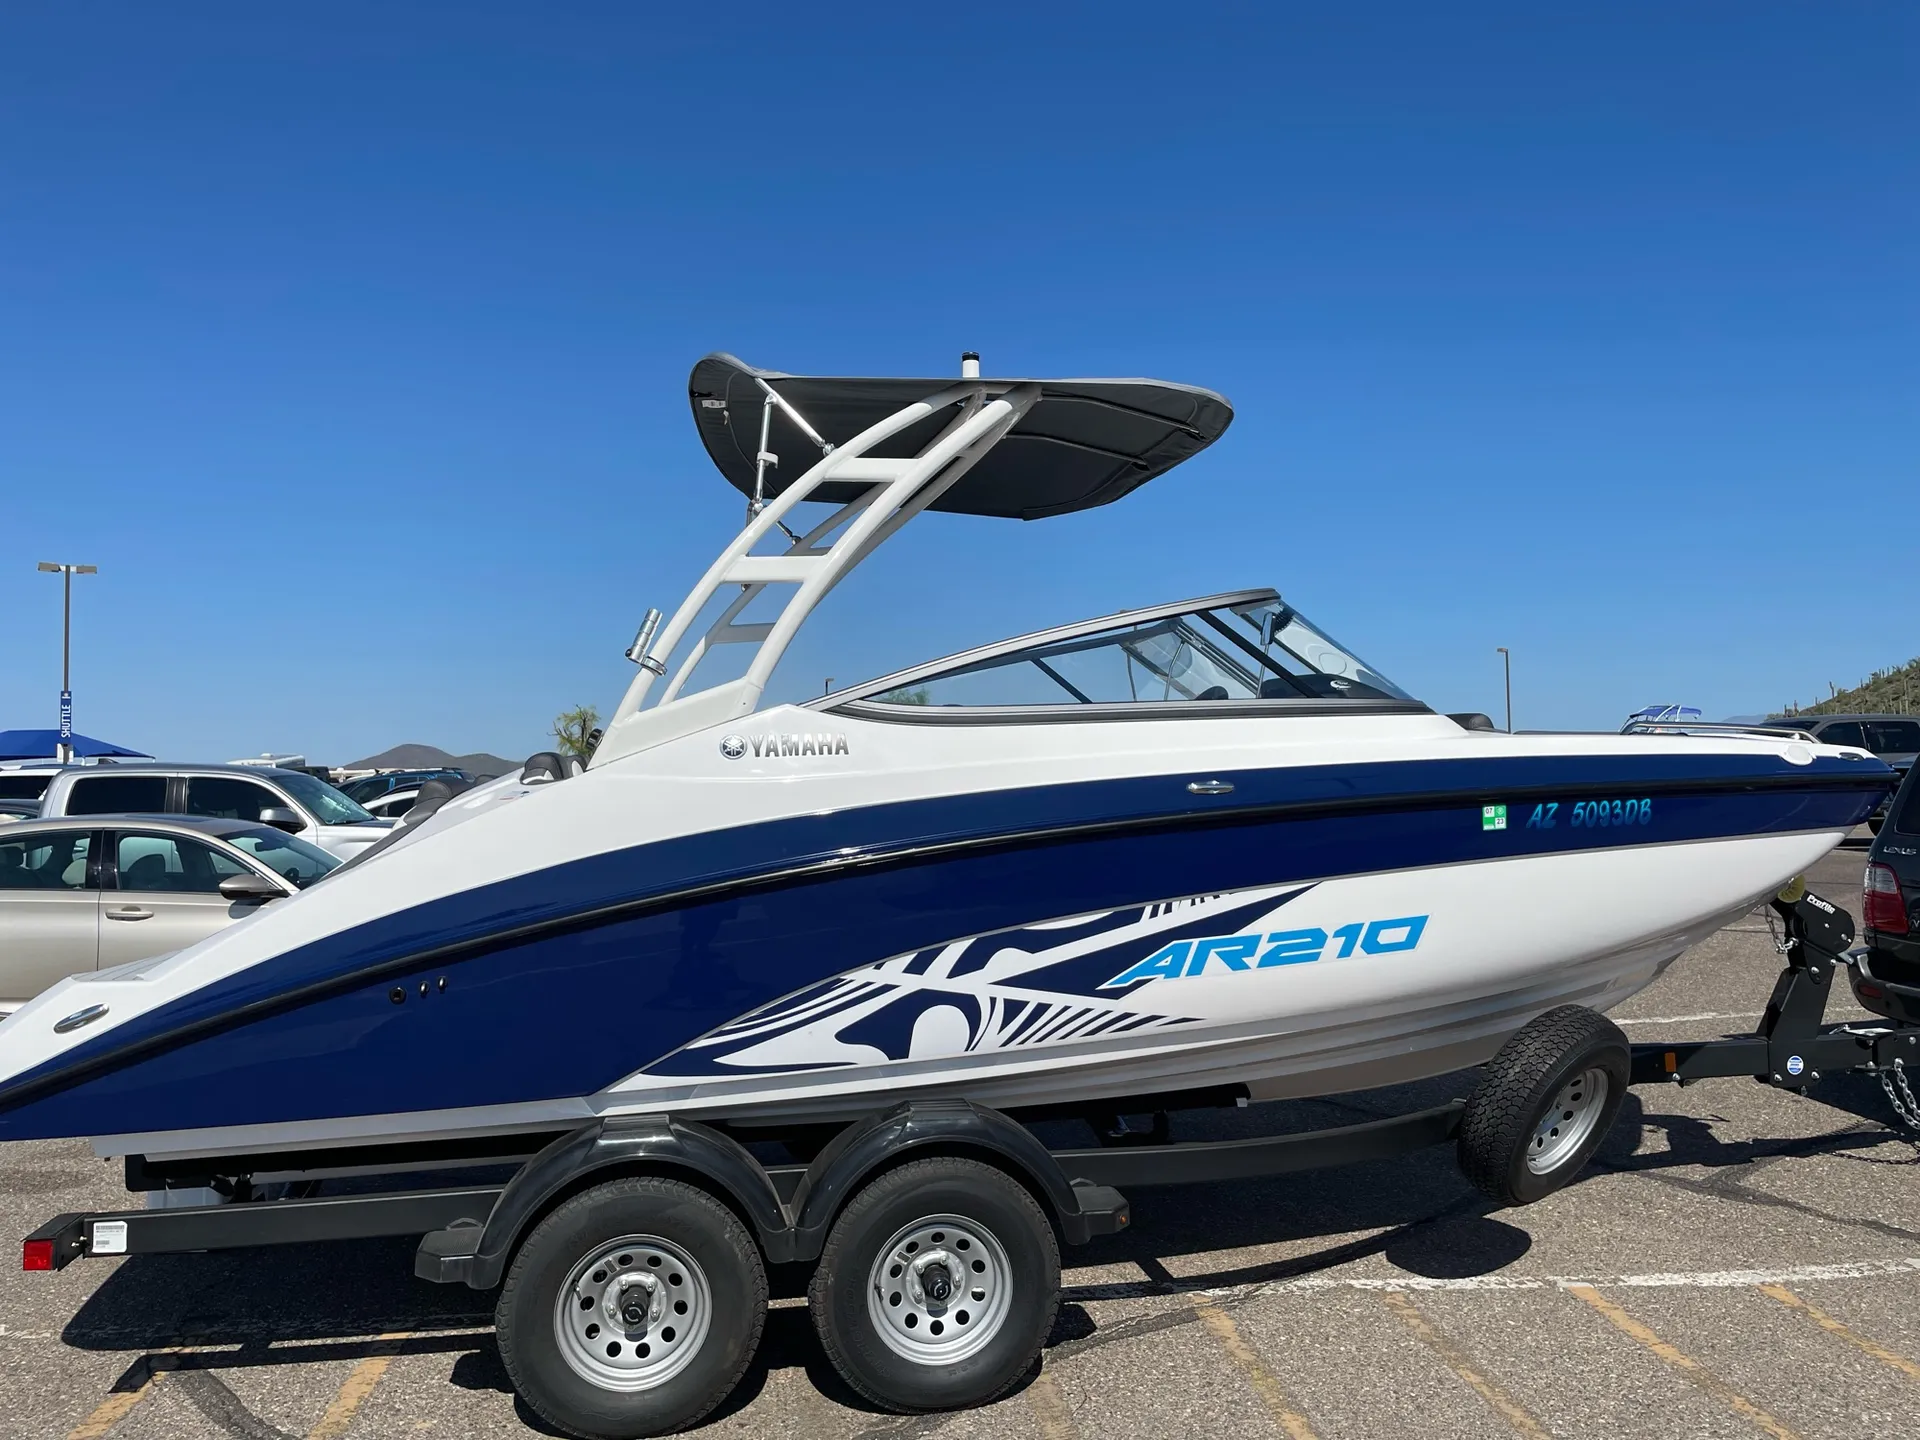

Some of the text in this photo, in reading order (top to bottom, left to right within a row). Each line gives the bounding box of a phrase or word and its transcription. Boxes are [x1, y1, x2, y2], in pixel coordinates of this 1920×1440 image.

[61, 704, 71, 738] SHUTTLE
[748, 732, 850, 758] YAMAHA
[1485, 807, 1493, 815] 07
[1525, 798, 1653, 829] AZ 5093DB
[1882, 845, 1918, 856] LEXUS
[1106, 914, 1430, 987] AR210
